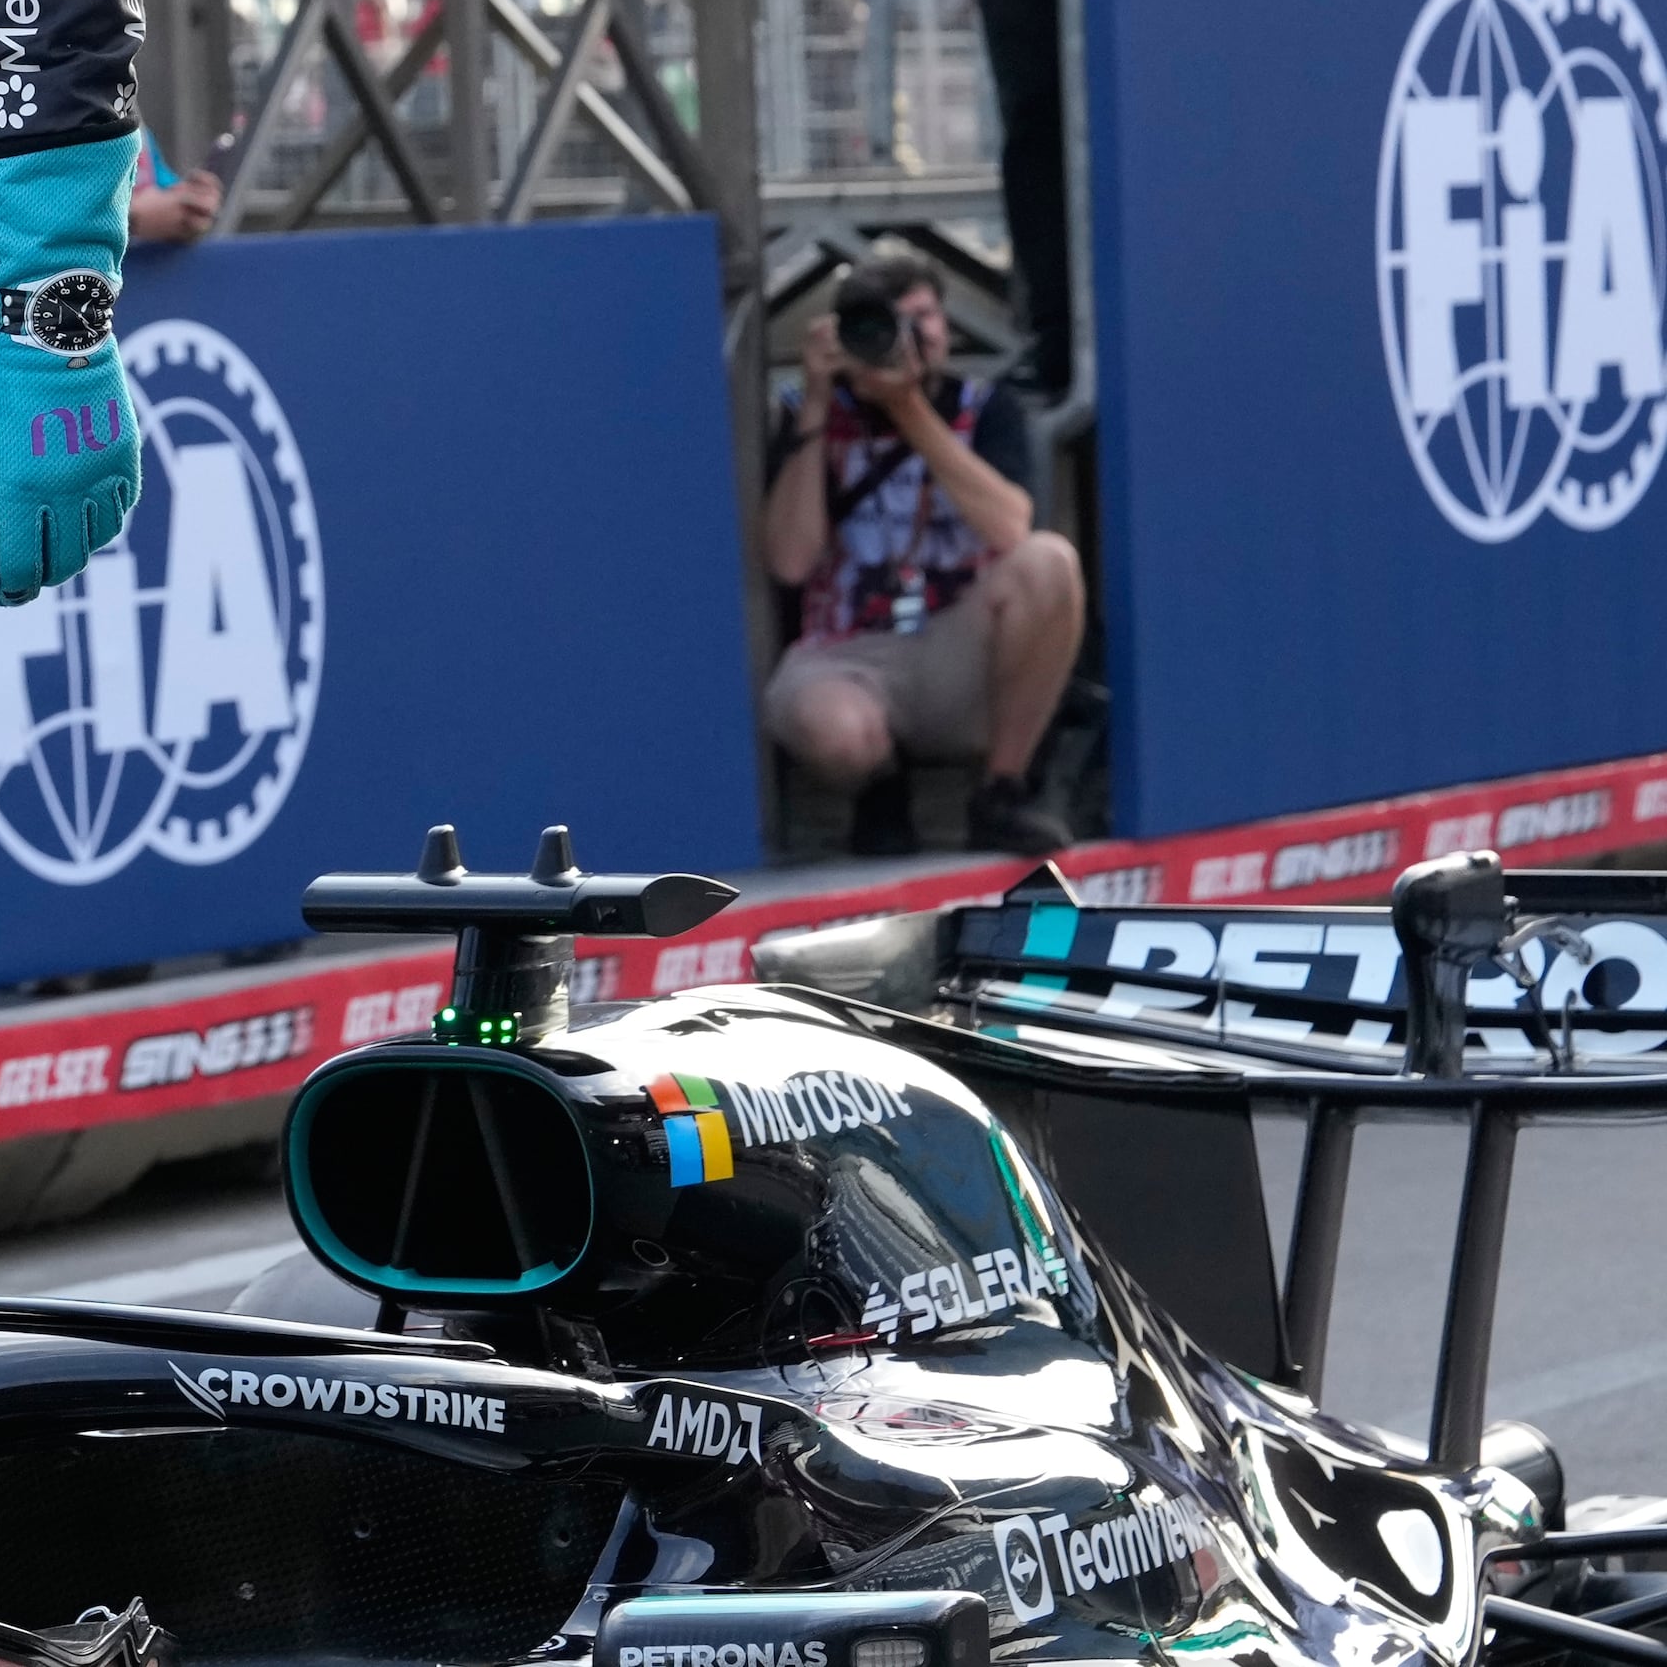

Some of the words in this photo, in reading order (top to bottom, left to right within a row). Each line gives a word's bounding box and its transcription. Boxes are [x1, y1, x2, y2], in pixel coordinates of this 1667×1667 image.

[30, 399, 121, 457] nu
[902, 1244, 1056, 1334] SOLERA
[197, 1367, 506, 1434] CROWDSTRIKE
[646, 1392, 731, 1460] AMD
[619, 1640, 828, 1667] PETRONAS
